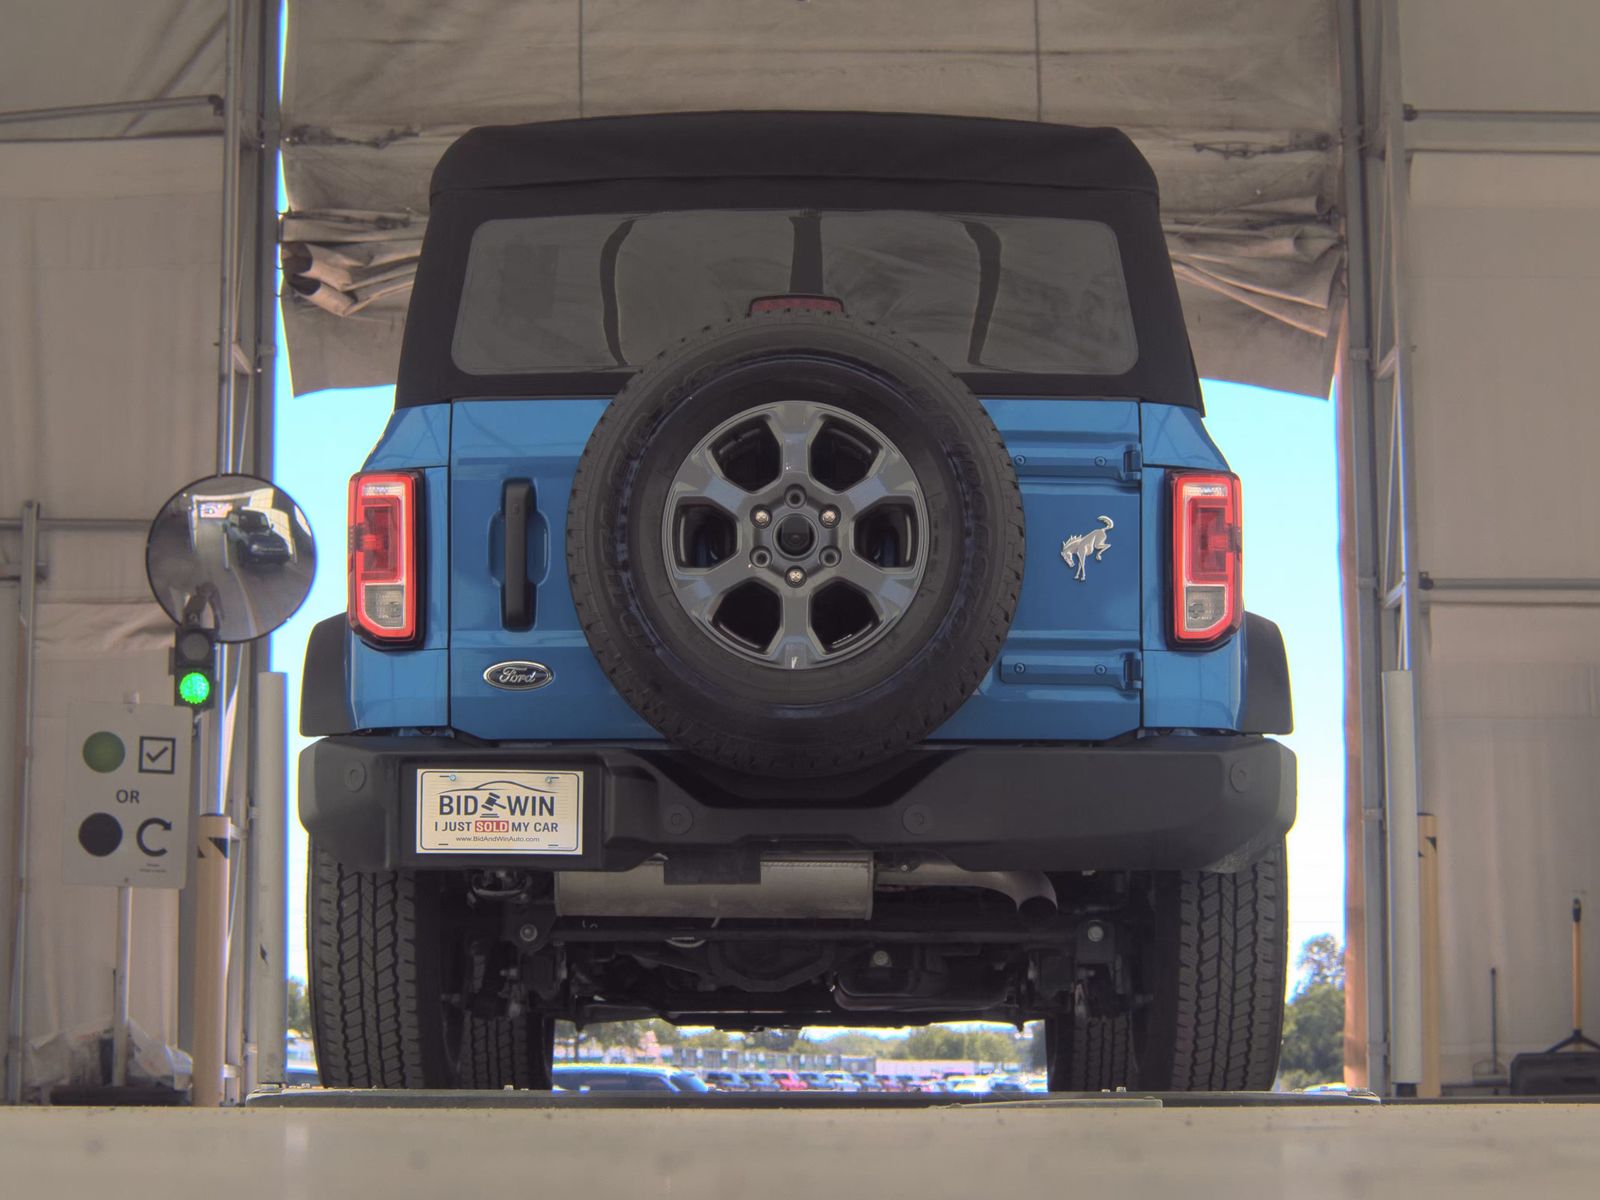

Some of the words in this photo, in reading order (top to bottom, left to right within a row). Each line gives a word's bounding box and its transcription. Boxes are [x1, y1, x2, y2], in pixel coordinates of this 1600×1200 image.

[499, 667, 536, 683] Ford
[116, 789, 140, 804] OR
[439, 795, 478, 816] BID
[507, 796, 555, 816] WIN
[434, 821, 438, 832] I
[442, 821, 472, 832] JUST
[475, 822, 508, 832] SOLD
[512, 822, 530, 832] MY
[534, 822, 559, 832] CAR
